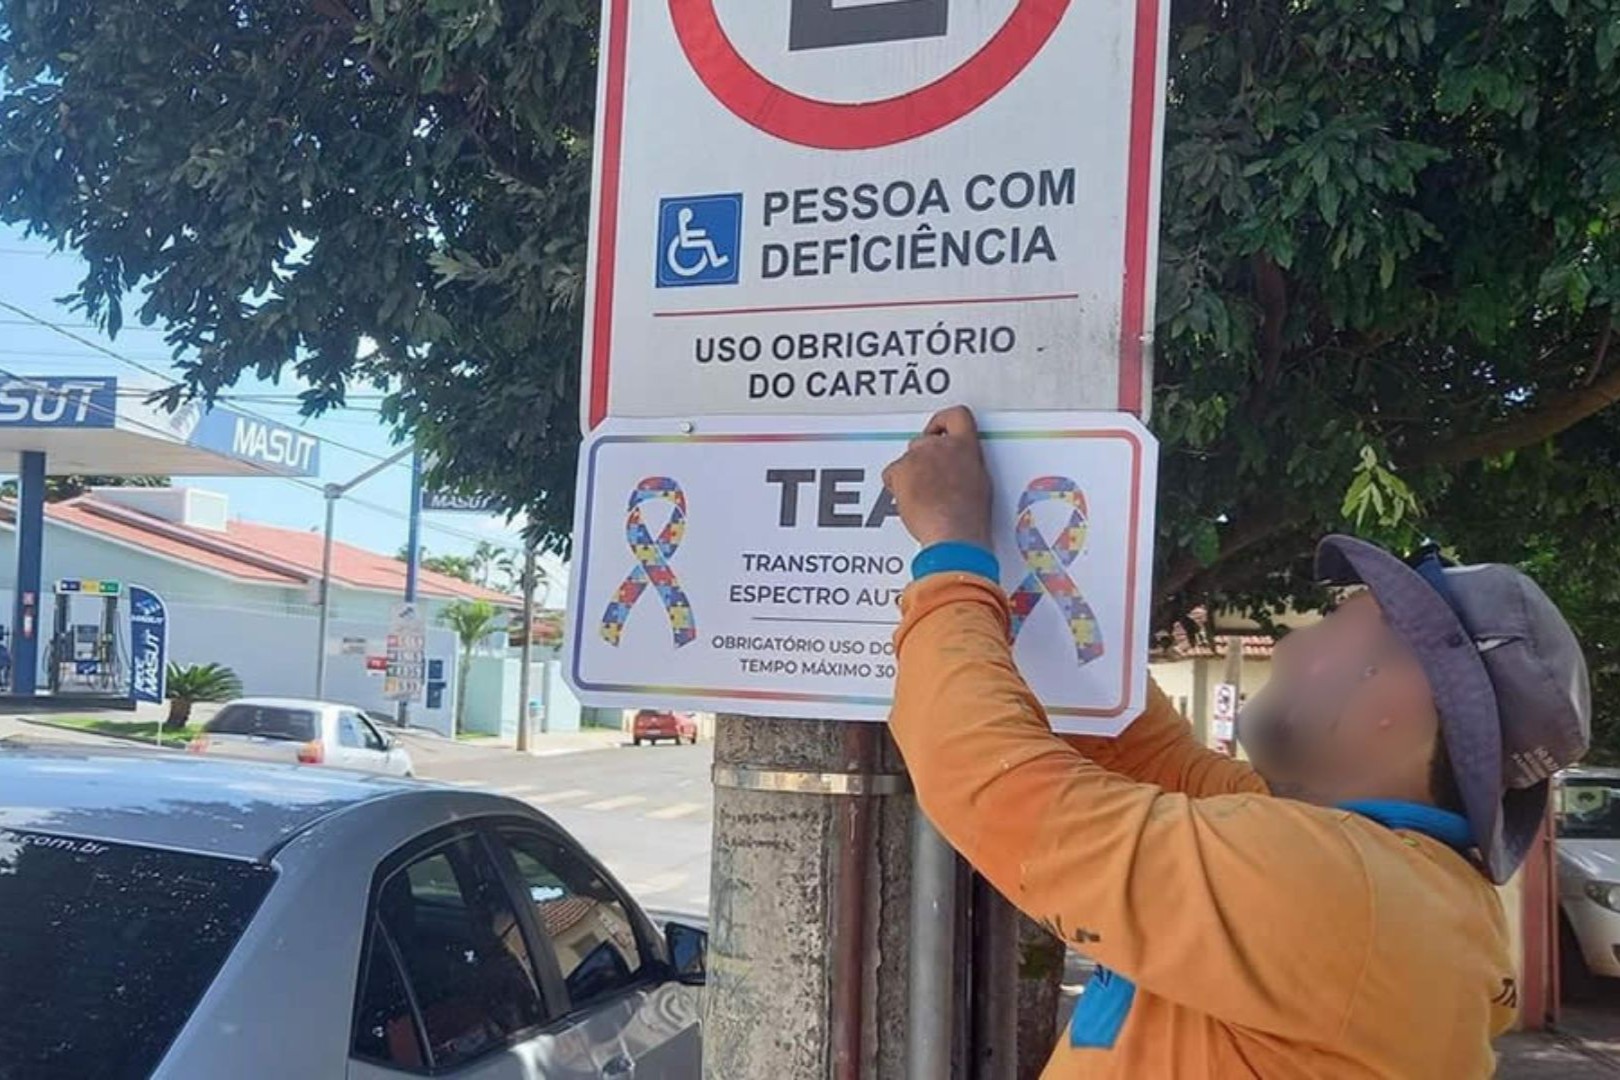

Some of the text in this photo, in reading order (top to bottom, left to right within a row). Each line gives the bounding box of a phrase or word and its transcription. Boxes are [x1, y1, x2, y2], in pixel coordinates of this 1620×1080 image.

[763, 167, 1077, 227] PESSOA COM
[761, 223, 1057, 279] DEFICIÊNCIA
[695, 321, 1016, 363] USO OBRIGATÓRIO
[748, 362, 950, 399] DO CARTÃO
[233, 416, 317, 471] MASUT
[742, 553, 905, 575] TRANSTORNO
[729, 584, 850, 606] ESPECTRO
[711, 634, 896, 657] OBRIGATÓRIO USO DO
[740, 658, 896, 679] TEMPO MÁXIMO 30
